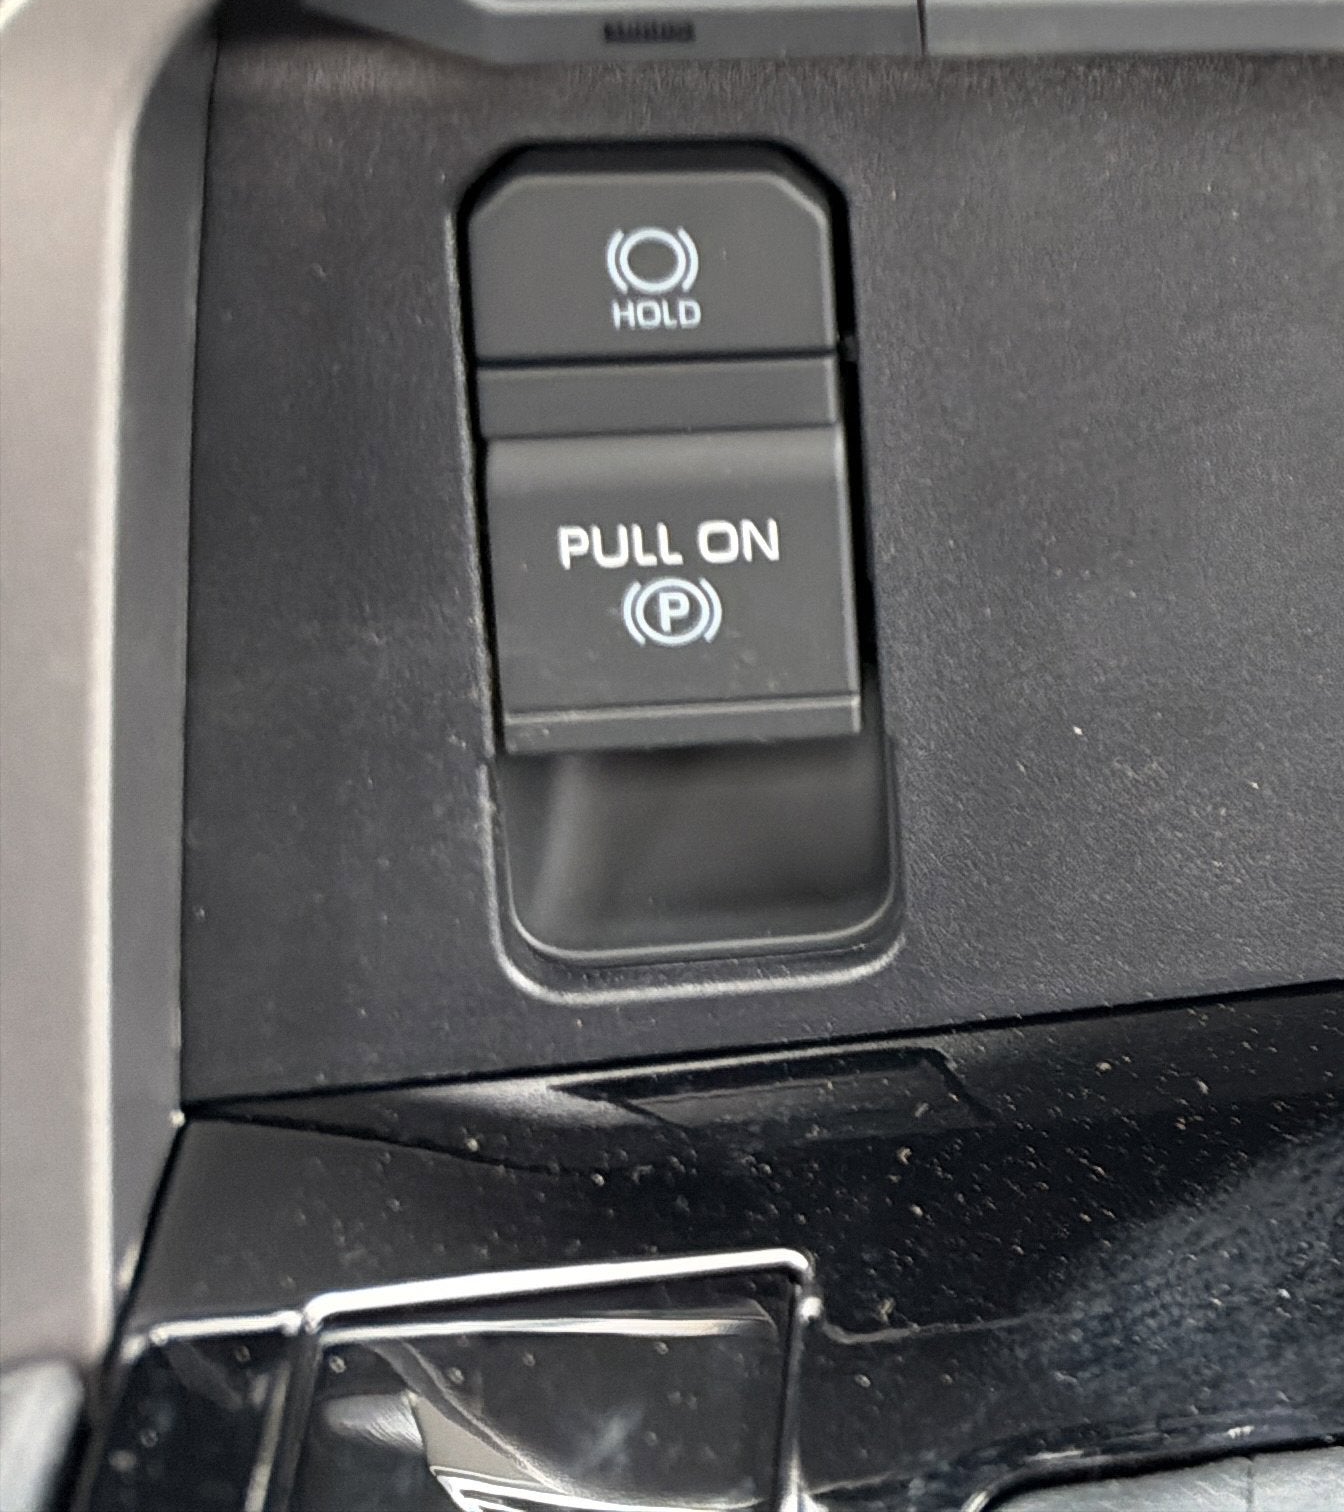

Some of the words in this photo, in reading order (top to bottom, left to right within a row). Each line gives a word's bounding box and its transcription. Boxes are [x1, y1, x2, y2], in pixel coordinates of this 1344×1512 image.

[612, 298, 702, 331] HOLD
[557, 521, 684, 571] PULL
[697, 517, 780, 565] ON
